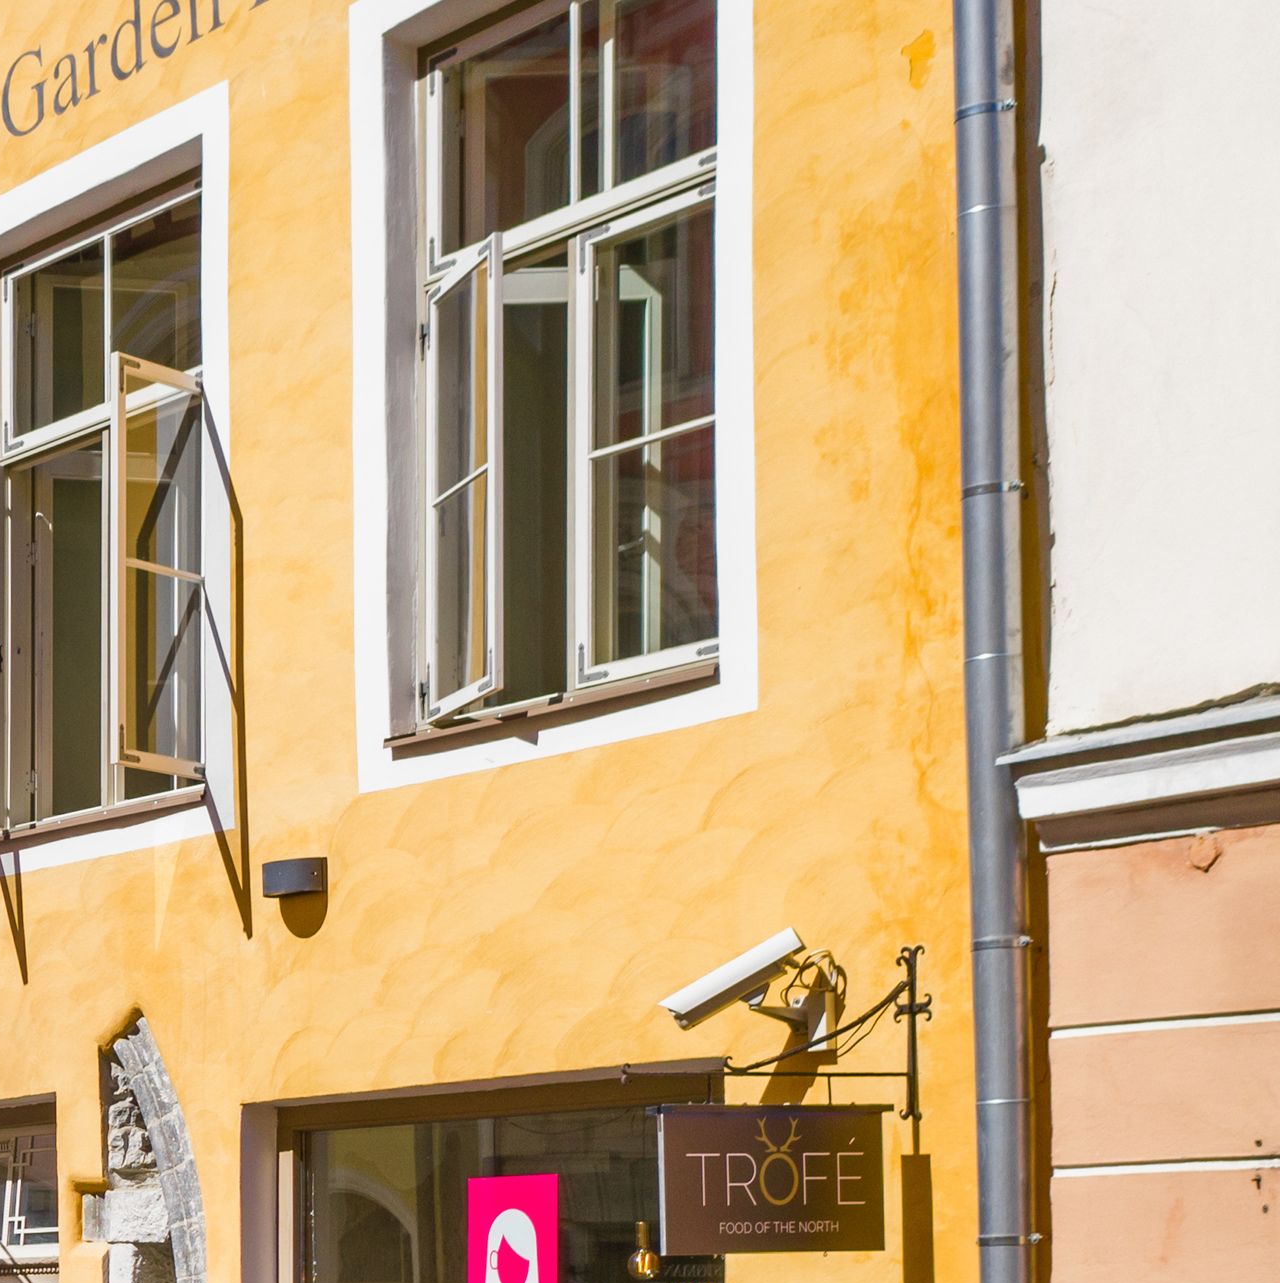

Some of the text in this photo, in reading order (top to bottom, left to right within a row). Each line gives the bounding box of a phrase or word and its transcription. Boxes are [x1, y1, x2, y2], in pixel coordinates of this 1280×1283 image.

[685, 1137, 867, 1207] TROFÉ
[719, 1220, 840, 1235] FOOD OF THE NORTH
